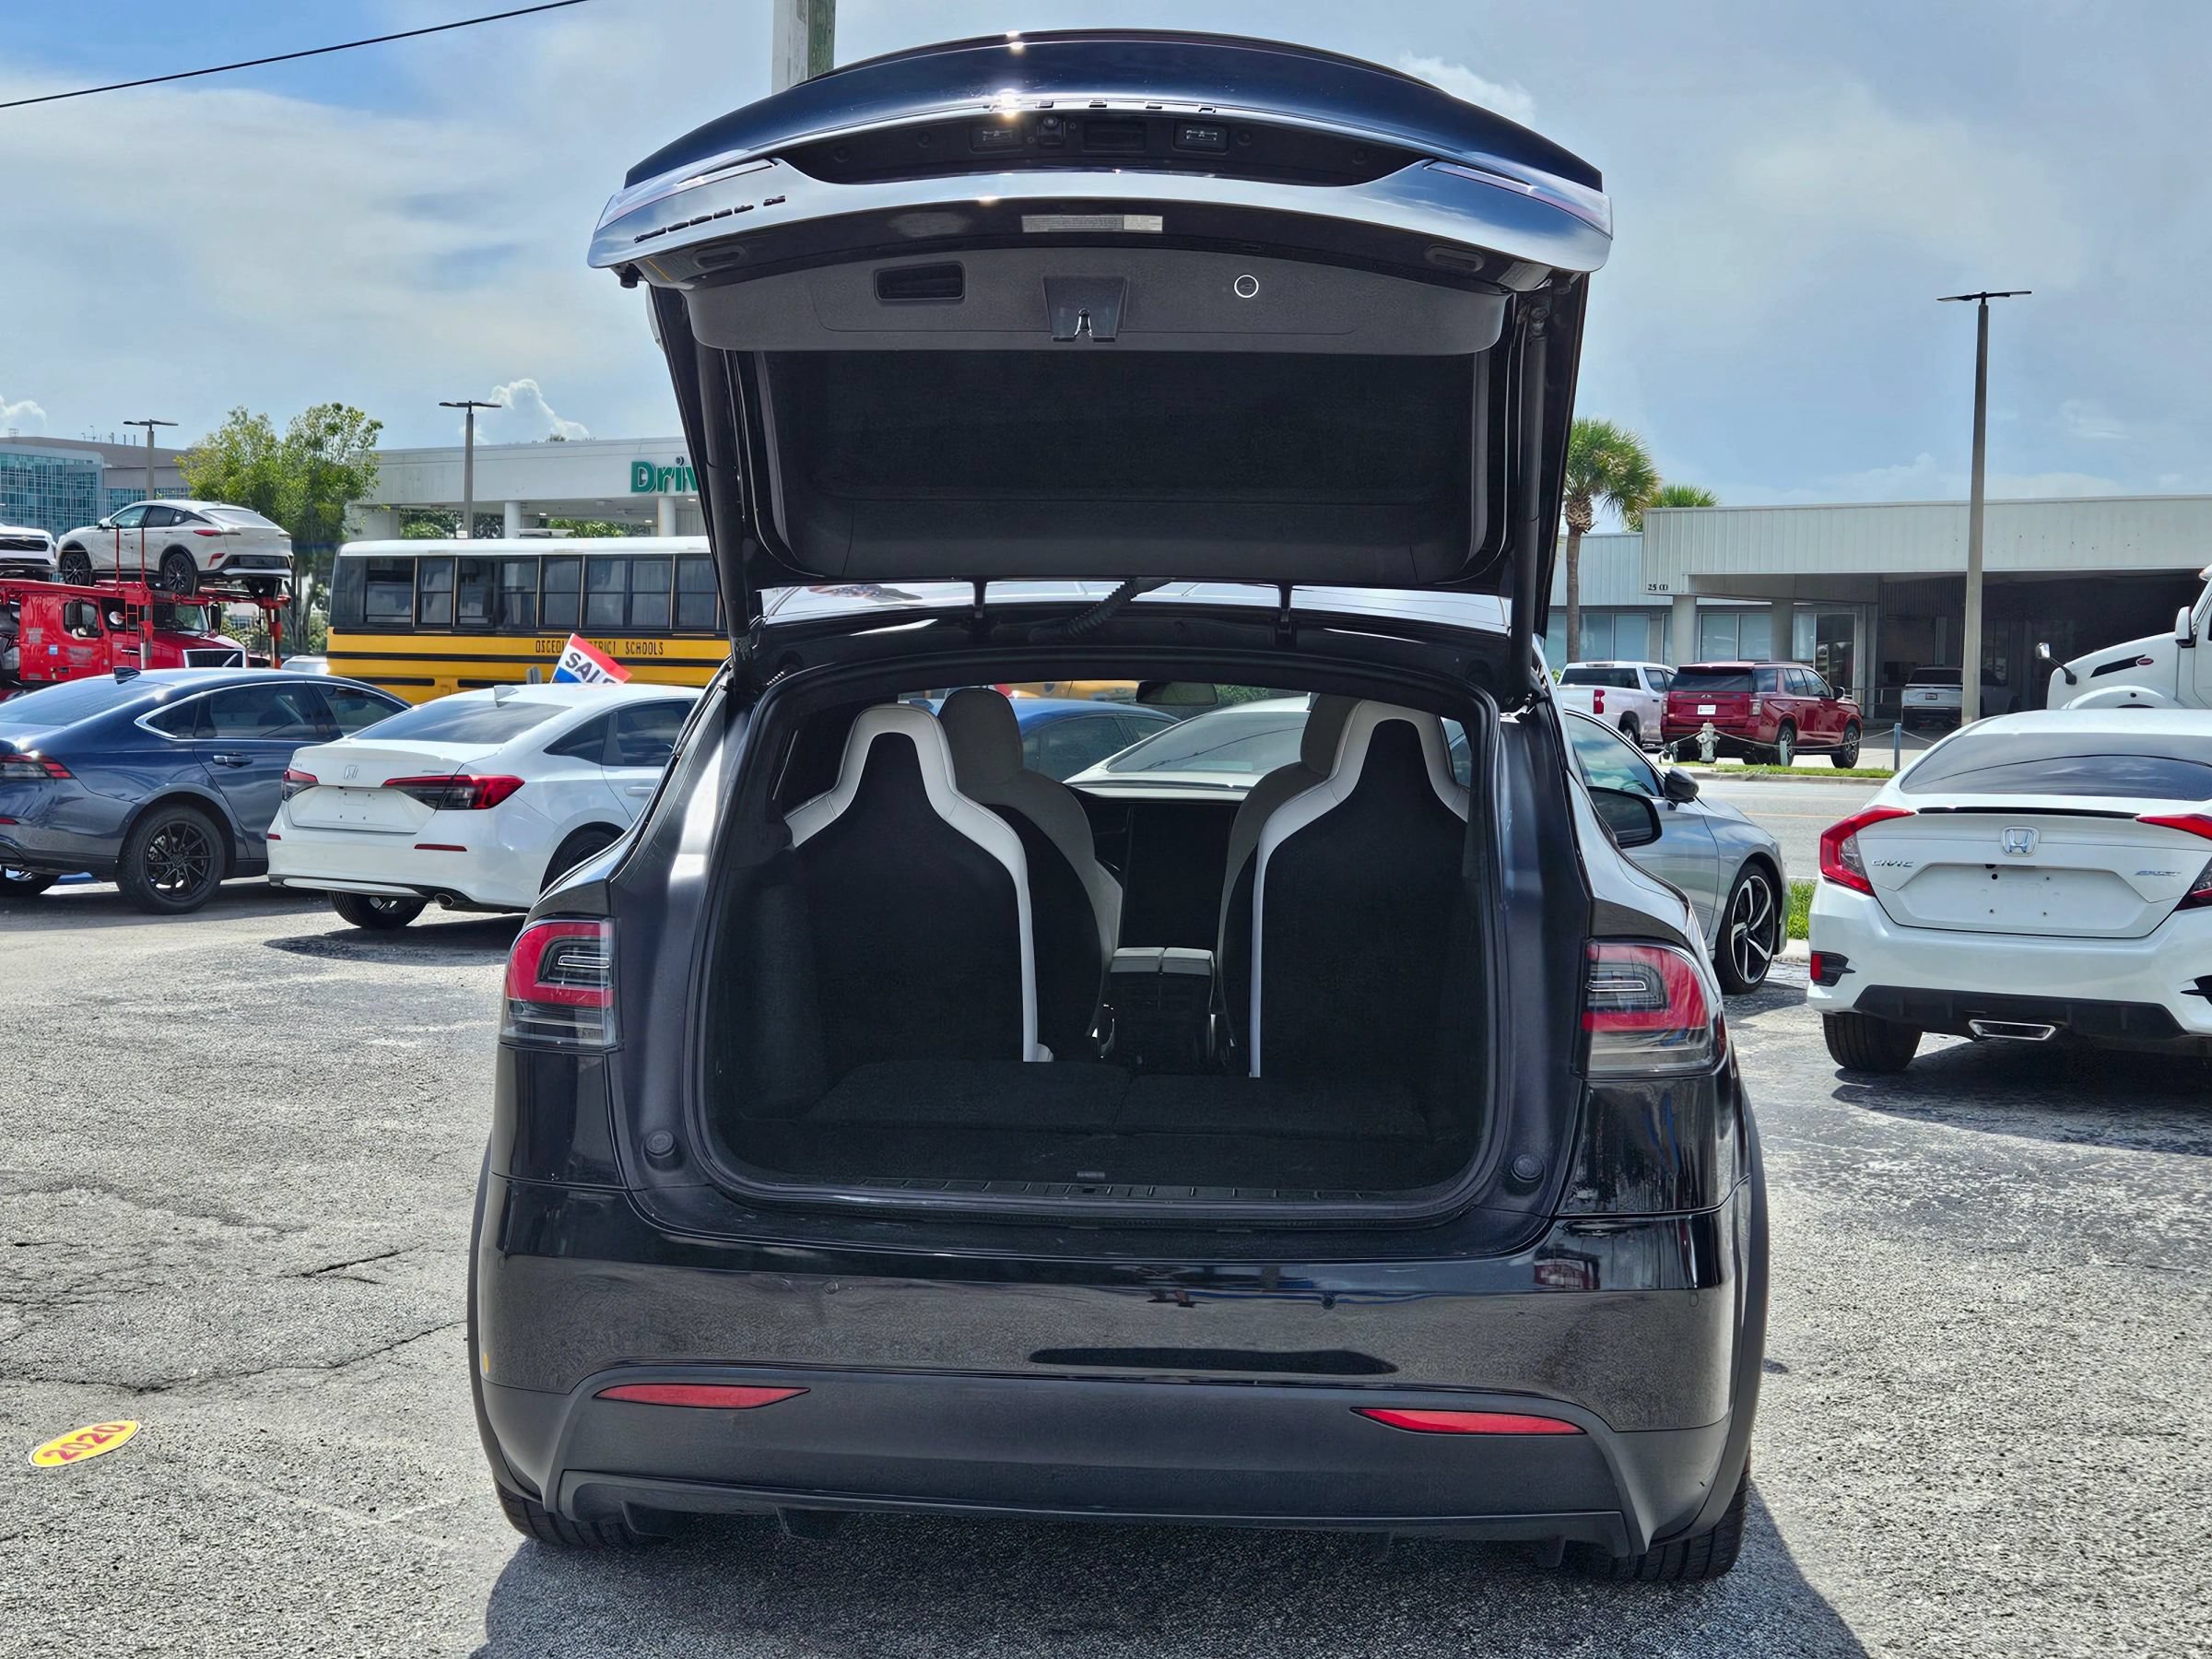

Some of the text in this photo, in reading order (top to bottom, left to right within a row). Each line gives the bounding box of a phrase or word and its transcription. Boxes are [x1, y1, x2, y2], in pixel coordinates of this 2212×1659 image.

[535, 640, 566, 653] OSCEOL
[626, 641, 663, 655] SCHOOLS
[42, 1424, 126, 1461] 2020
